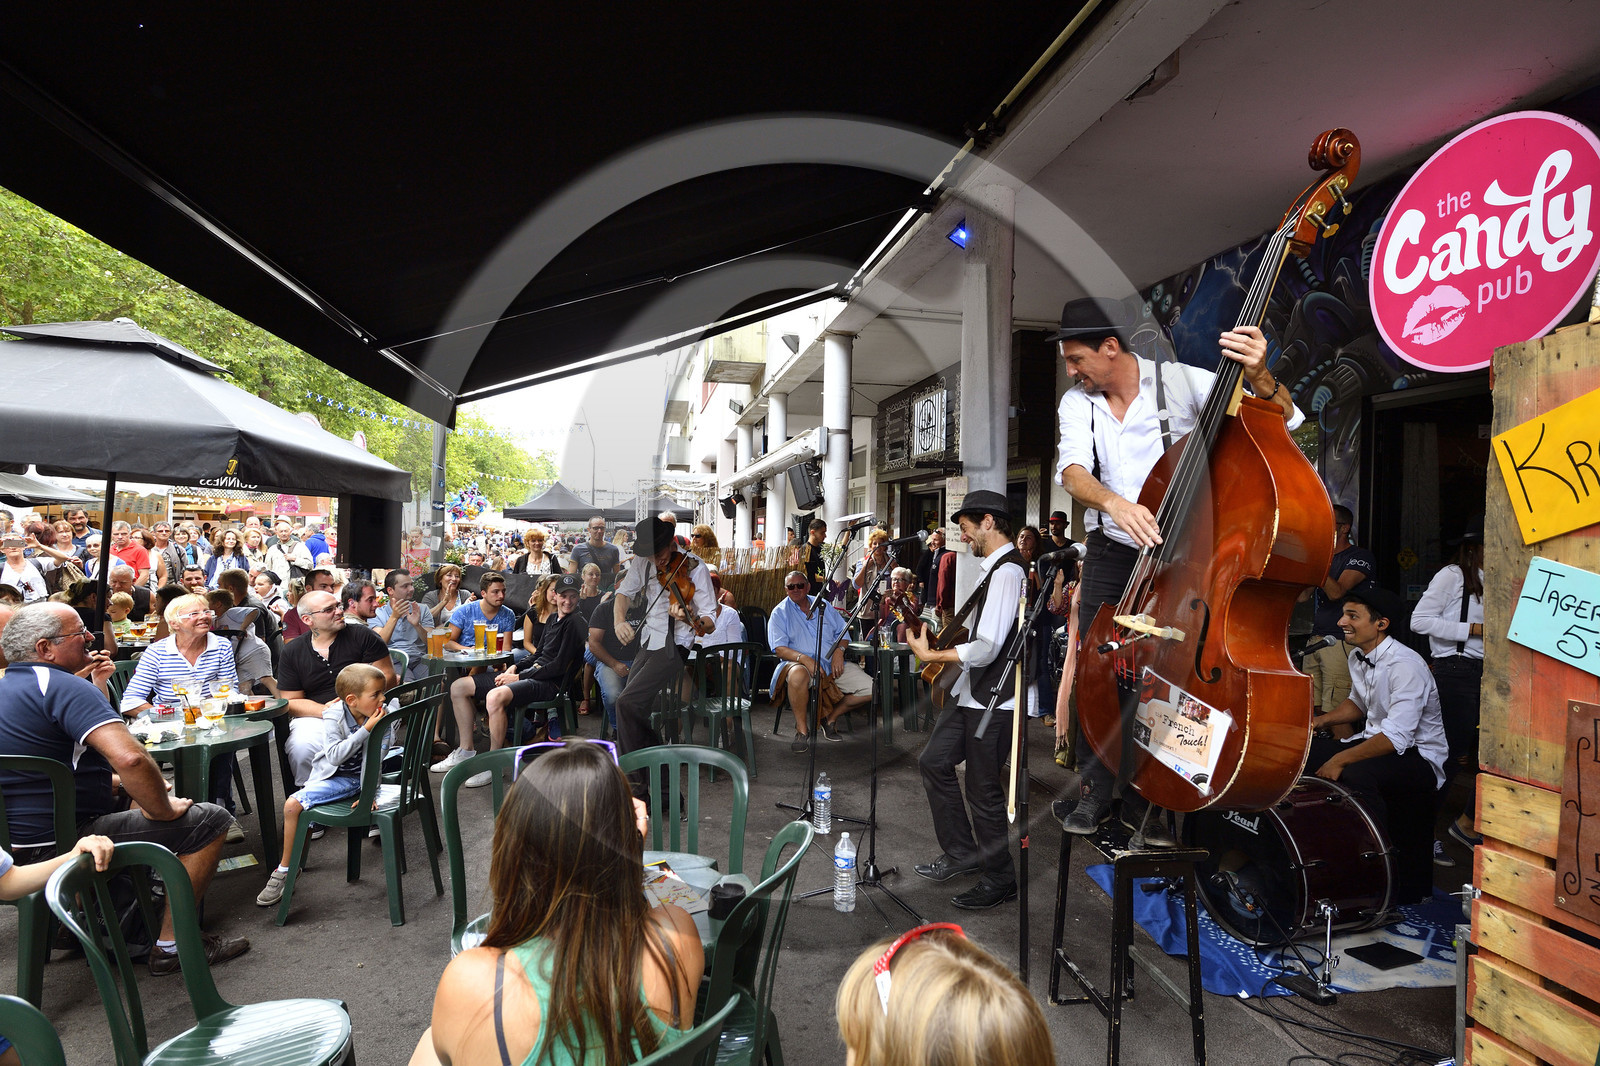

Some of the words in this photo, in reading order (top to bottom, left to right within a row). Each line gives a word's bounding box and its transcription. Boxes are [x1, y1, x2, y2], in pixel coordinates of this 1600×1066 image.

[1437, 190, 1471, 218] the
[1383, 149, 1594, 295] Candy
[1477, 264, 1533, 313] pub
[1503, 422, 1600, 513] KR
[1162, 714, 1195, 736] French
[1176, 734, 1208, 747] Touch!
[1222, 810, 1260, 831] Pearl
